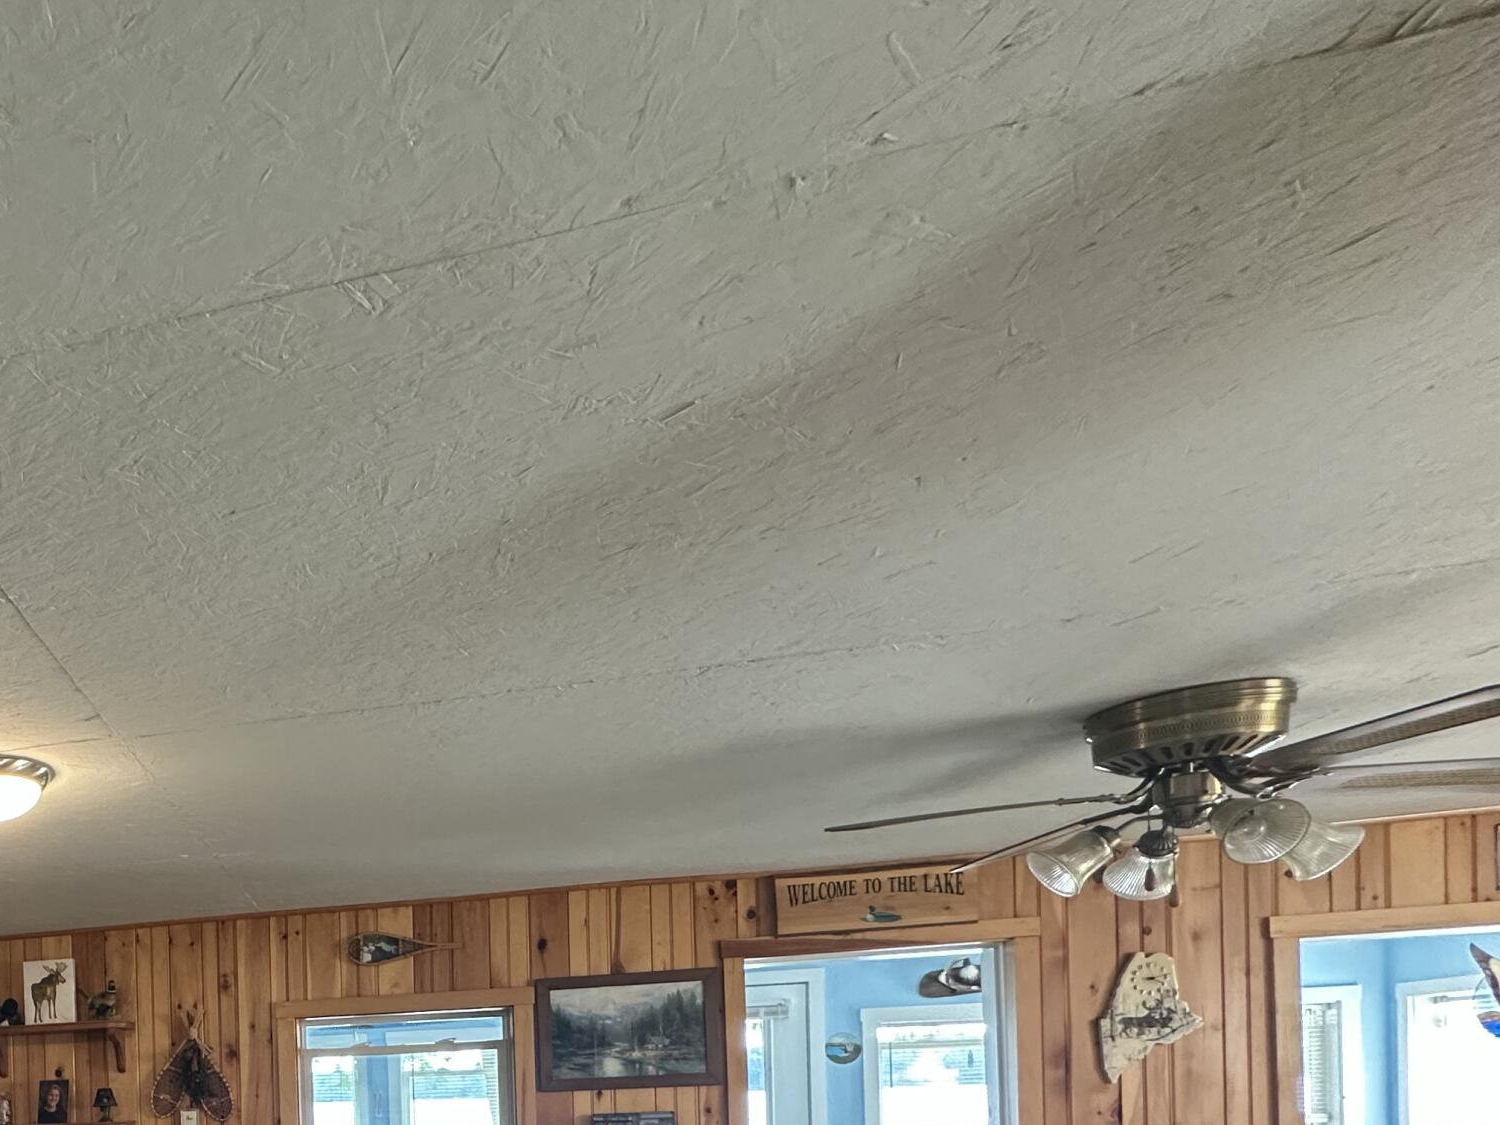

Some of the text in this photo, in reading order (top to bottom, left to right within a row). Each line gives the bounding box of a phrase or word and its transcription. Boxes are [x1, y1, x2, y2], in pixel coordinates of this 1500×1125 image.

[787, 872, 965, 907] WELCOME TO THE LAKE
